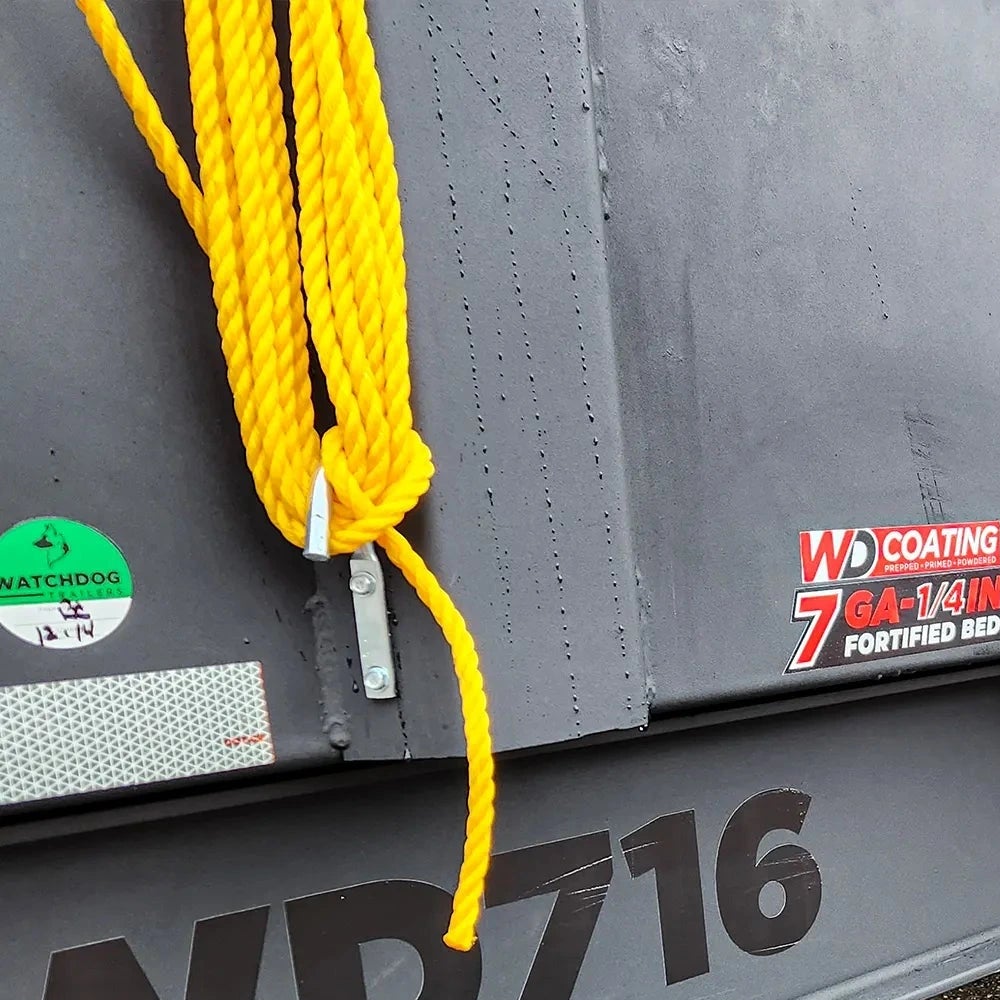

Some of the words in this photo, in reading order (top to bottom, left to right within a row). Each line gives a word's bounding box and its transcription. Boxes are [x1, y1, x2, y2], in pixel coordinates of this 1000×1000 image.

[799, 529, 877, 583] WD
[882, 525, 999, 562] COATING
[884, 561, 919, 573] PREPPED
[924, 559, 952, 569] PRIMED
[957, 556, 997, 567] POWDERED
[0, 571, 120, 590] WATCHDOG
[47, 587, 124, 599] TRAILERS
[793, 588, 843, 672] 7
[843, 621, 957, 658] FORTIFIED
